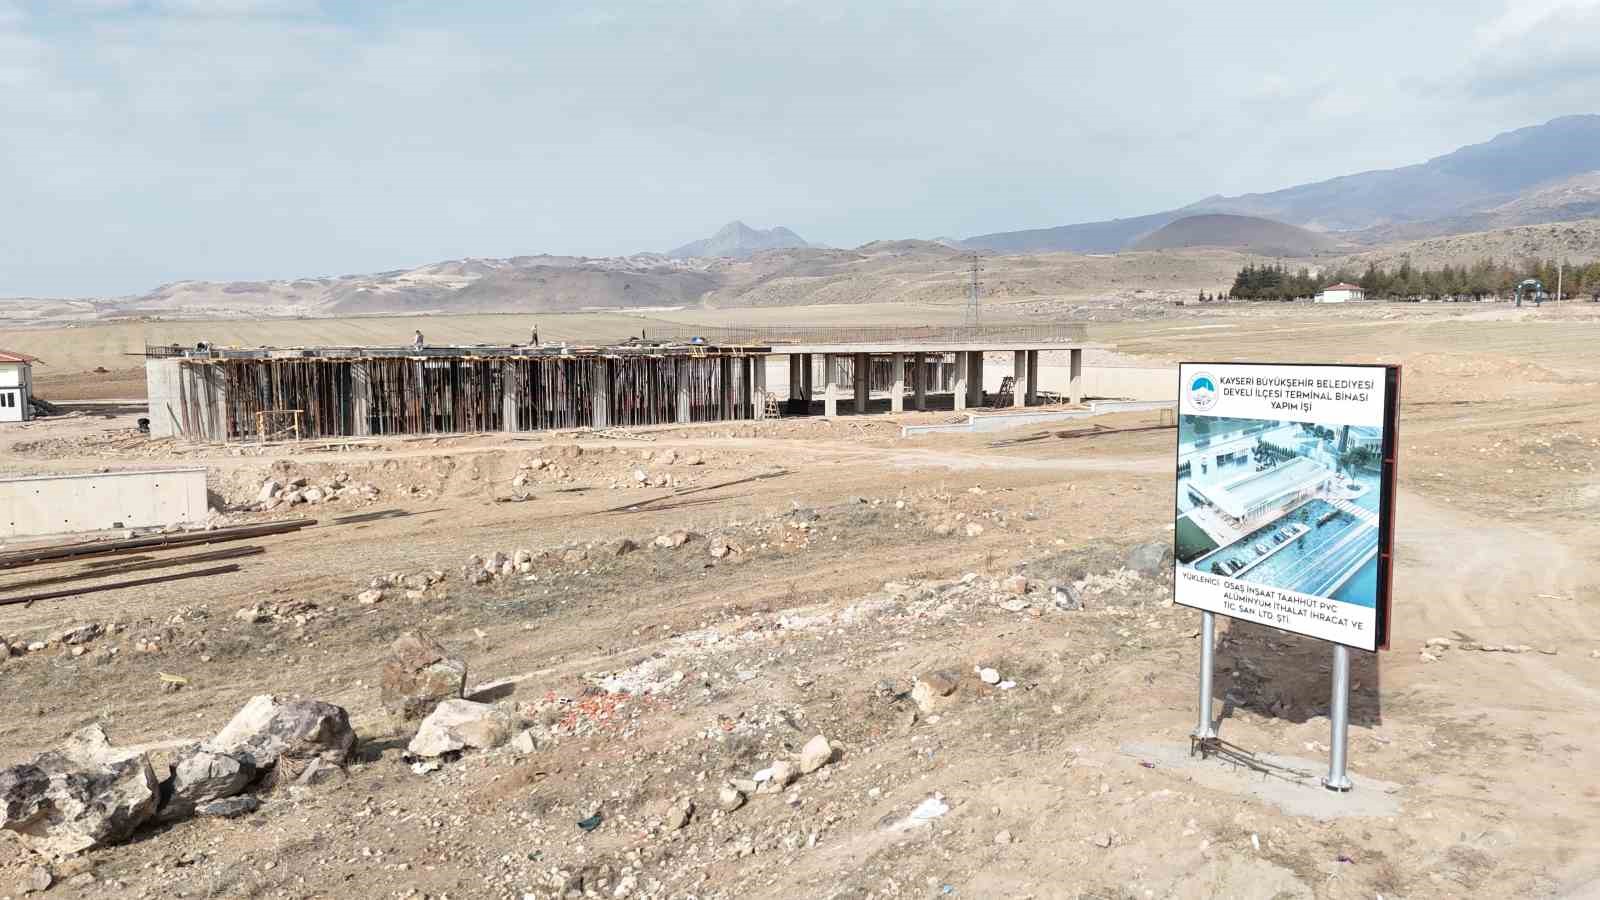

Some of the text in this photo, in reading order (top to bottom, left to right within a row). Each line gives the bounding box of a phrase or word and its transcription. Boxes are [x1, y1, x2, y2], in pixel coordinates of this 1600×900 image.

[1220, 376, 1374, 390] KAYSERİ BÜYÜKŞEHİR BELEDİYESİ
[1223, 387, 1369, 402] DEVELİ İLÇESİ TERMİNAL BİNASI
[1271, 401, 1312, 413] YAPIM İŞİ
[1320, 602, 1338, 613] PVC
[1351, 621, 1364, 630] VE
